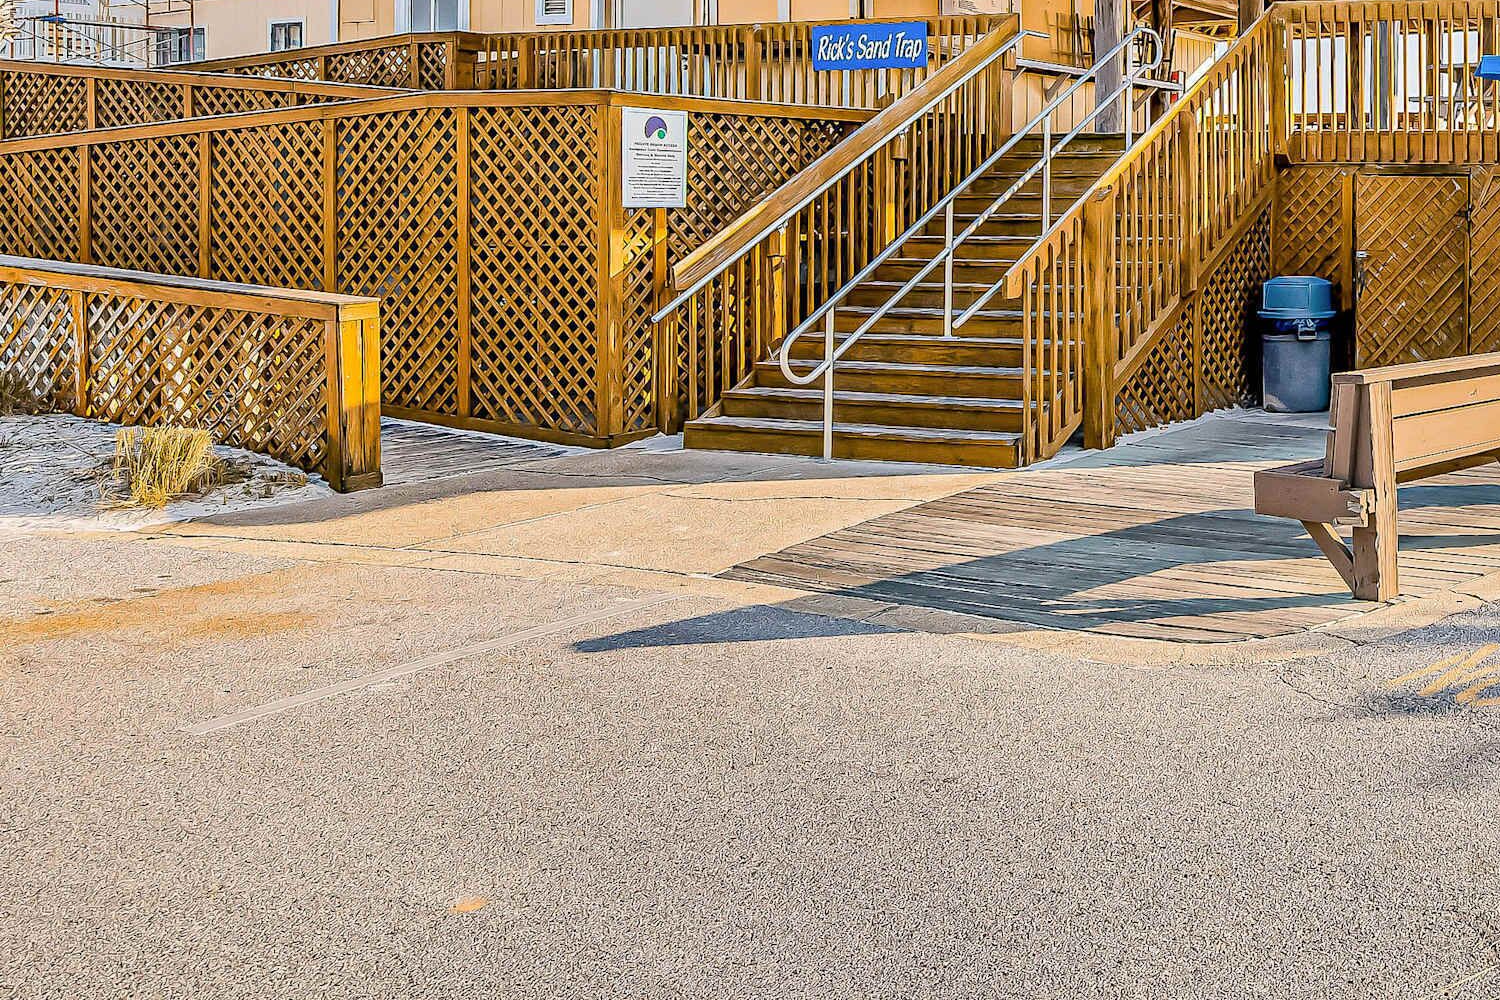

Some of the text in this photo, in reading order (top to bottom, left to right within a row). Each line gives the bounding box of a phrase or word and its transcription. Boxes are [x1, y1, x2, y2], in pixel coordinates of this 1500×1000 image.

[817, 31, 923, 62] Rick's Sand Trap
